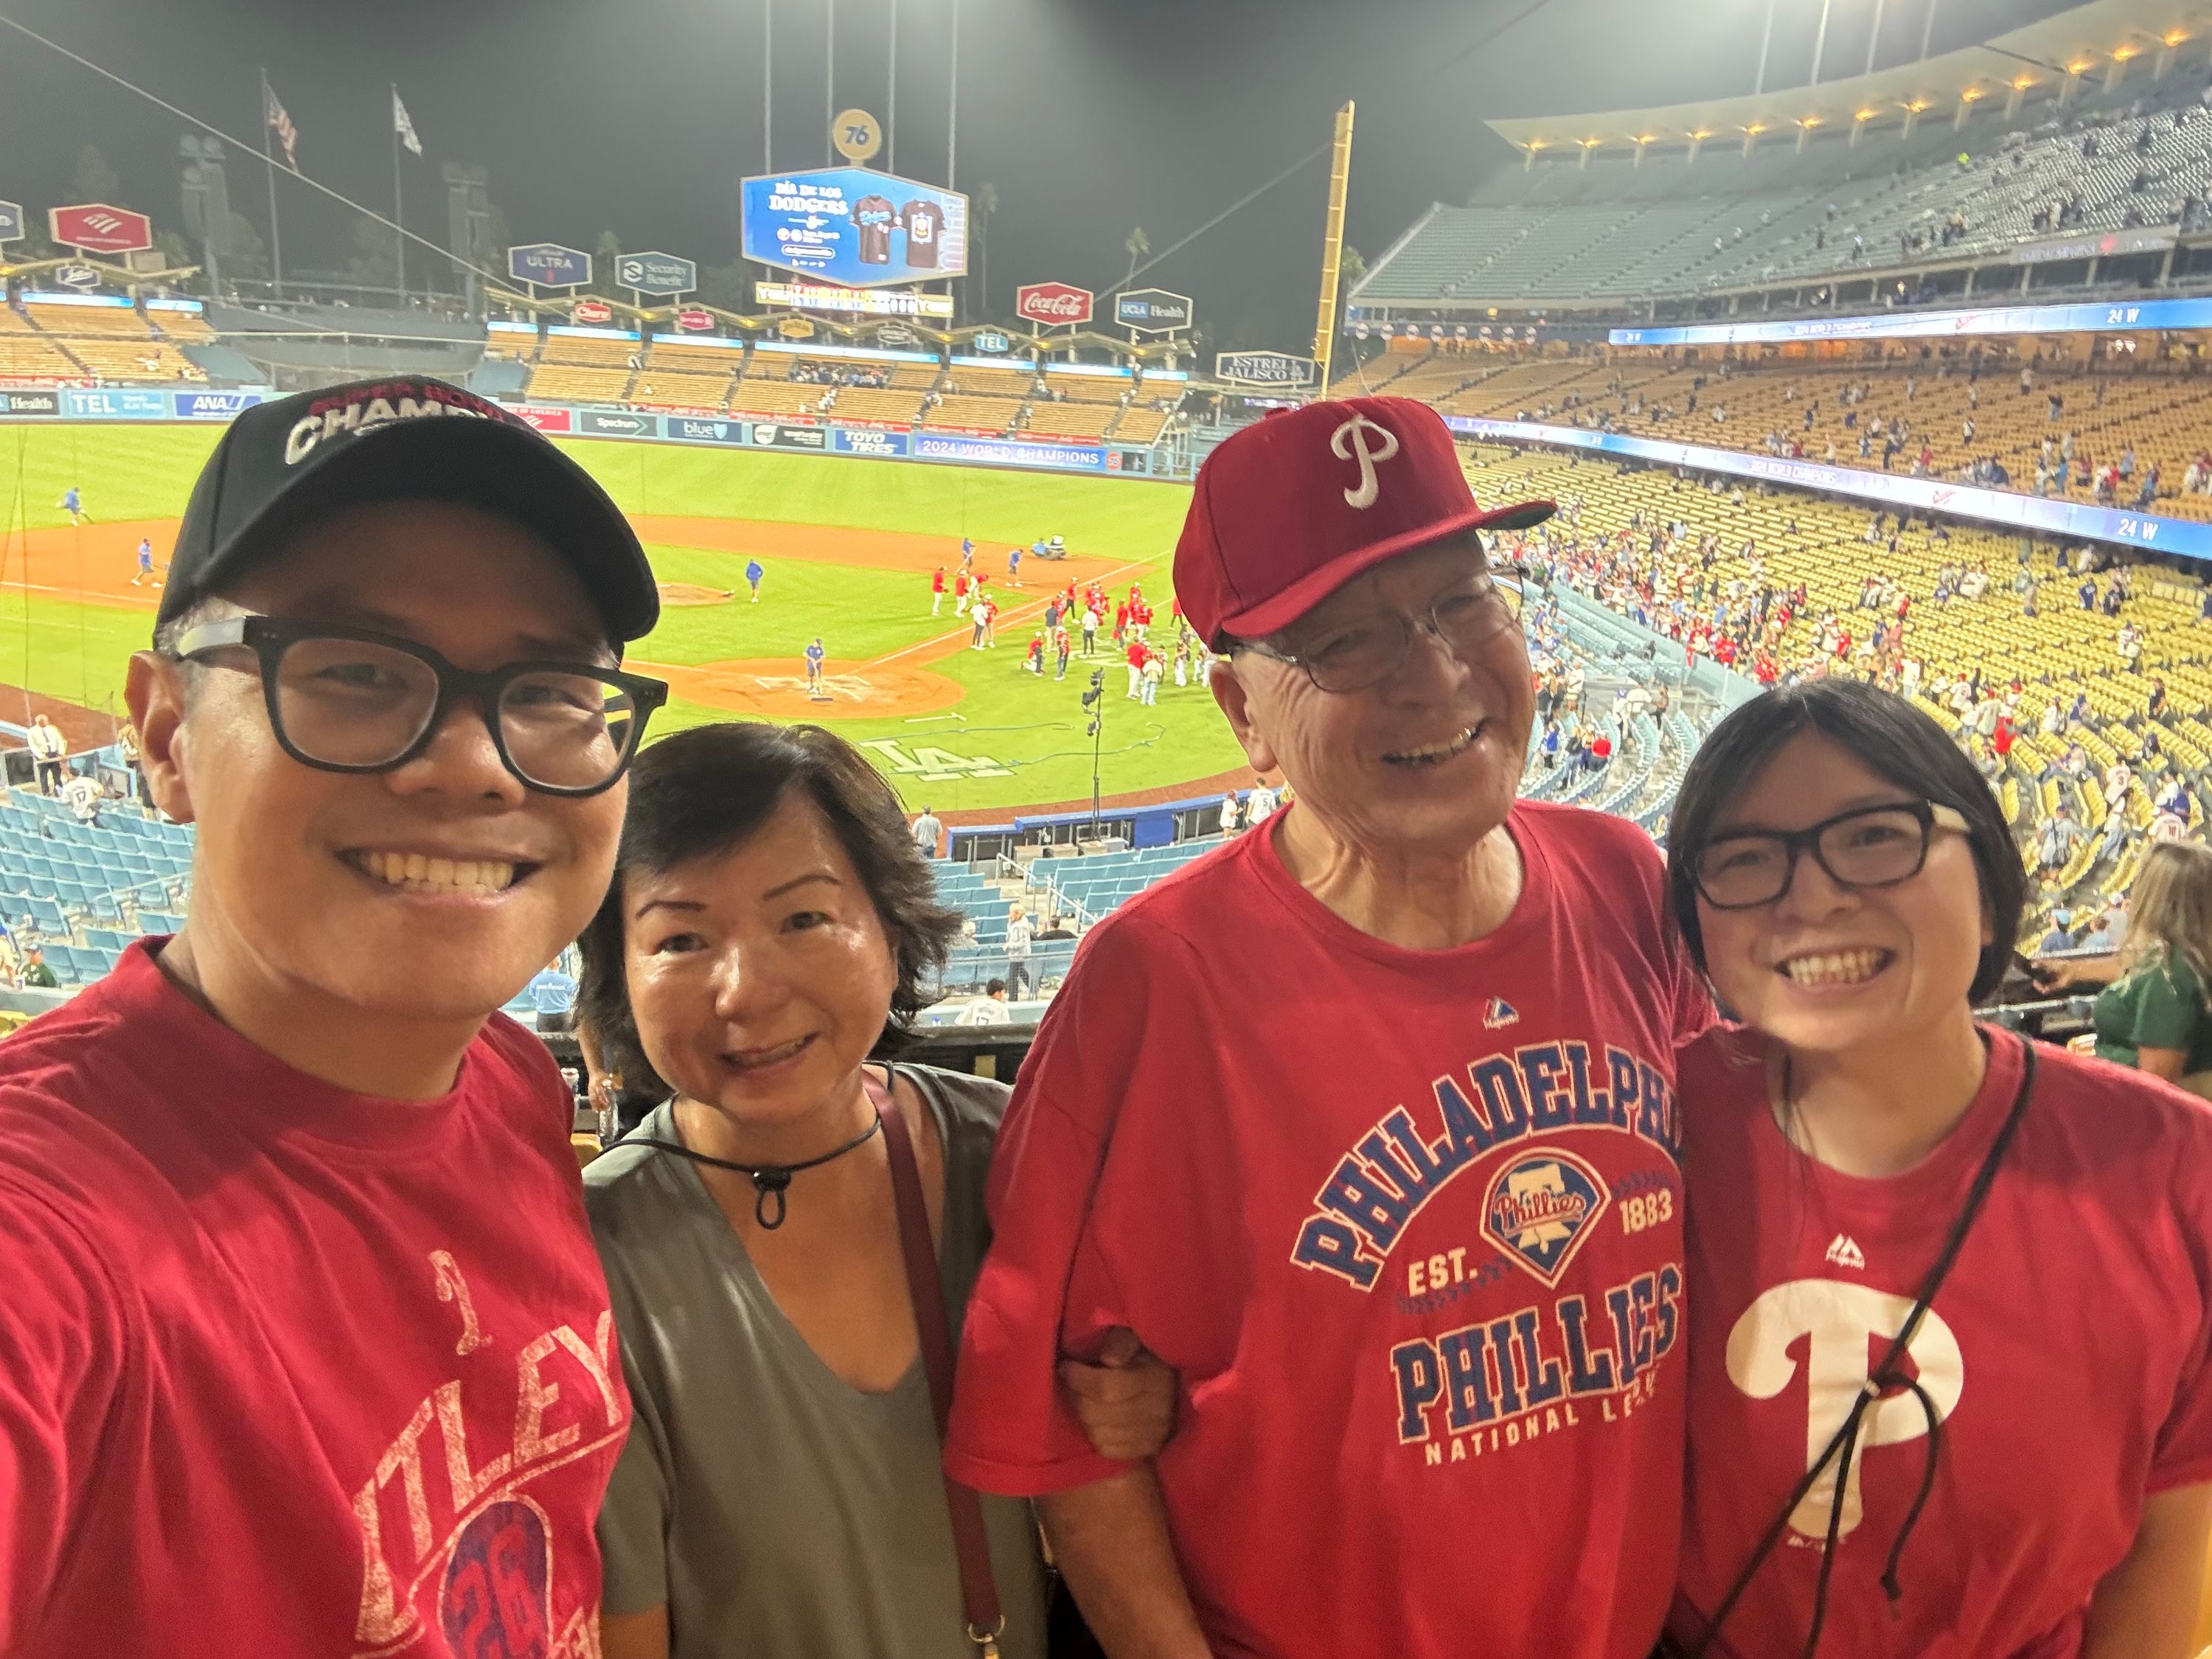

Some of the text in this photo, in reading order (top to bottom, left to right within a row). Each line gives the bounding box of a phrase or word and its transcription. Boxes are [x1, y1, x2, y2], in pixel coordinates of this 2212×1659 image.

[845, 125, 871, 146] 76
[769, 195, 849, 215] DODGERS
[526, 256, 573, 270] ULTRA
[1121, 304, 1147, 316] UCLA
[978, 335, 1005, 349] TEL
[1224, 366, 1287, 380] JALISCO
[72, 394, 117, 413] TEL
[192, 396, 228, 410] ANA
[285, 397, 488, 465] CHAM
[684, 421, 714, 435] blue
[845, 431, 886, 443] TOYO
[851, 441, 898, 454] TIRES
[922, 440, 1099, 464] 2024 WORLD CHAMPIONS
[1330, 413, 1399, 510] P
[2118, 518, 2159, 541] 24 W
[1262, 797, 1269, 807] 5
[1495, 1189, 1588, 1240] Phillies
[1618, 1186, 1673, 1236] 1883
[1408, 1247, 1478, 1297] EST.
[1390, 1262, 1682, 1445] PHILLIES
[1726, 1278, 1964, 1539] P
[1425, 1403, 1580, 1467] NATIONAL
